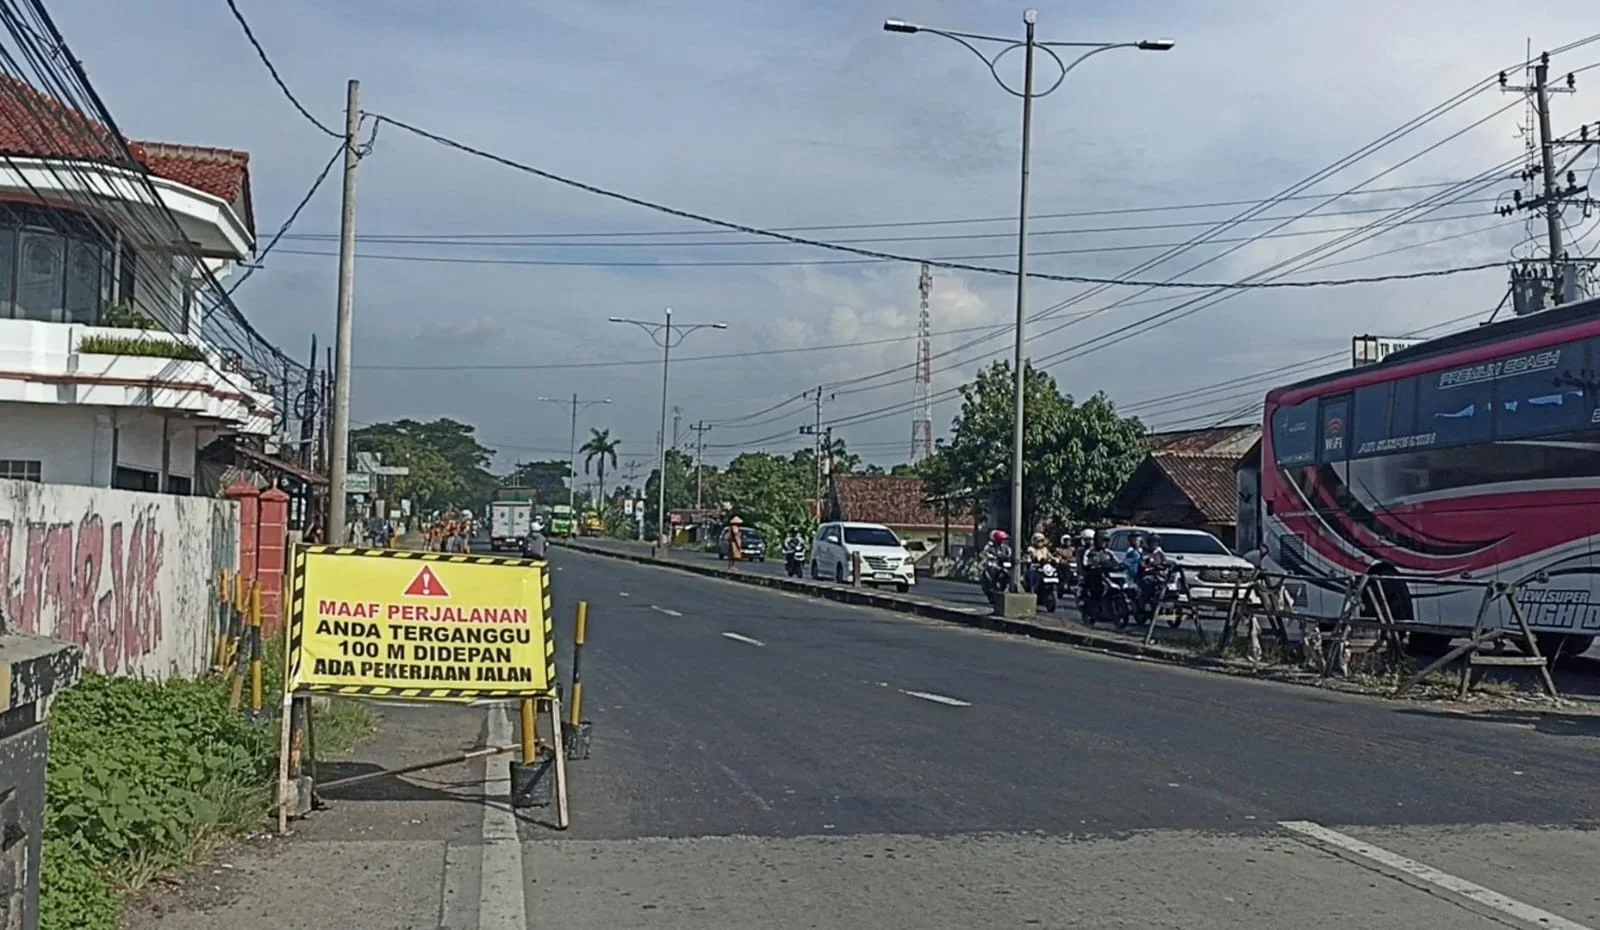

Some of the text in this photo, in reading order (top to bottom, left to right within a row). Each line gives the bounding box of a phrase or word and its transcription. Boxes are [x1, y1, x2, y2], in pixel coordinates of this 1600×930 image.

[1547, 591, 1588, 604] SUPER
[319, 600, 528, 624] MAAF PERJALANAN
[316, 620, 530, 644] ANDA TERGANGGU
[338, 641, 511, 663] 100 M DIDEPAN
[314, 659, 532, 682] ADA PEKERJAAN JALAN
